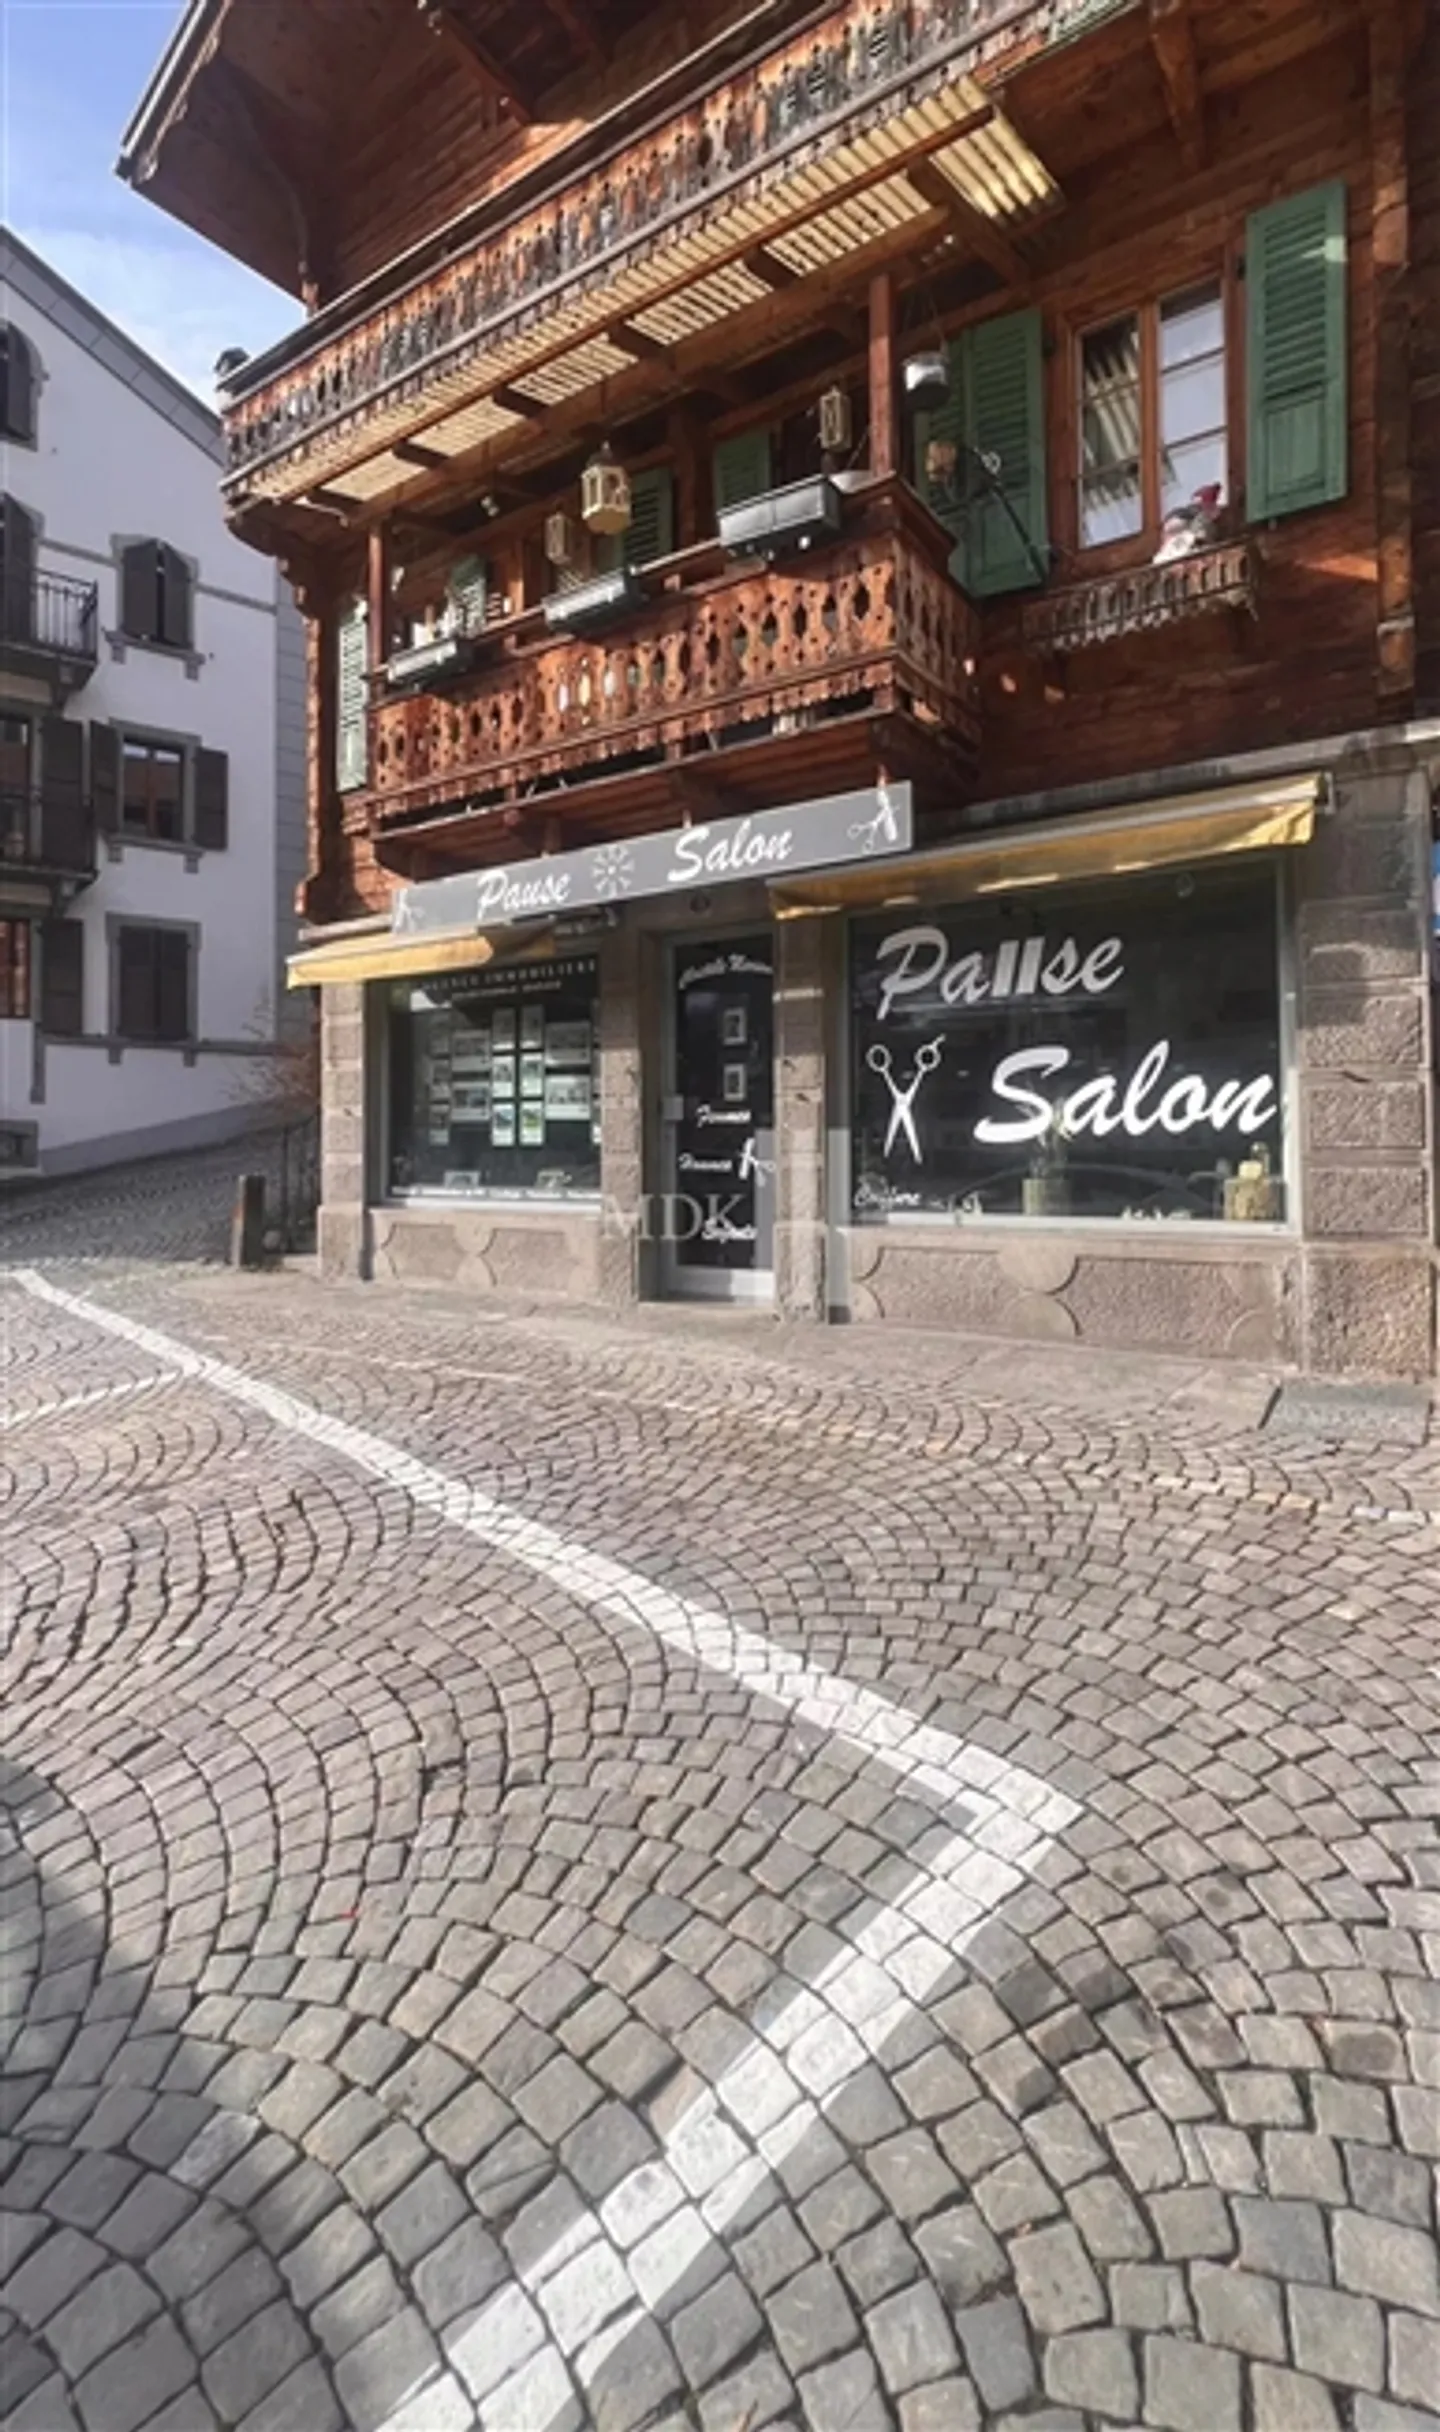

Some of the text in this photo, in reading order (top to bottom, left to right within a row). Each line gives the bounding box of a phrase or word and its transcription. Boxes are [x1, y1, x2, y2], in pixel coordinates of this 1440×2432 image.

[477, 822, 794, 921] Pause Salon
[973, 1039, 1278, 1144] Salon
